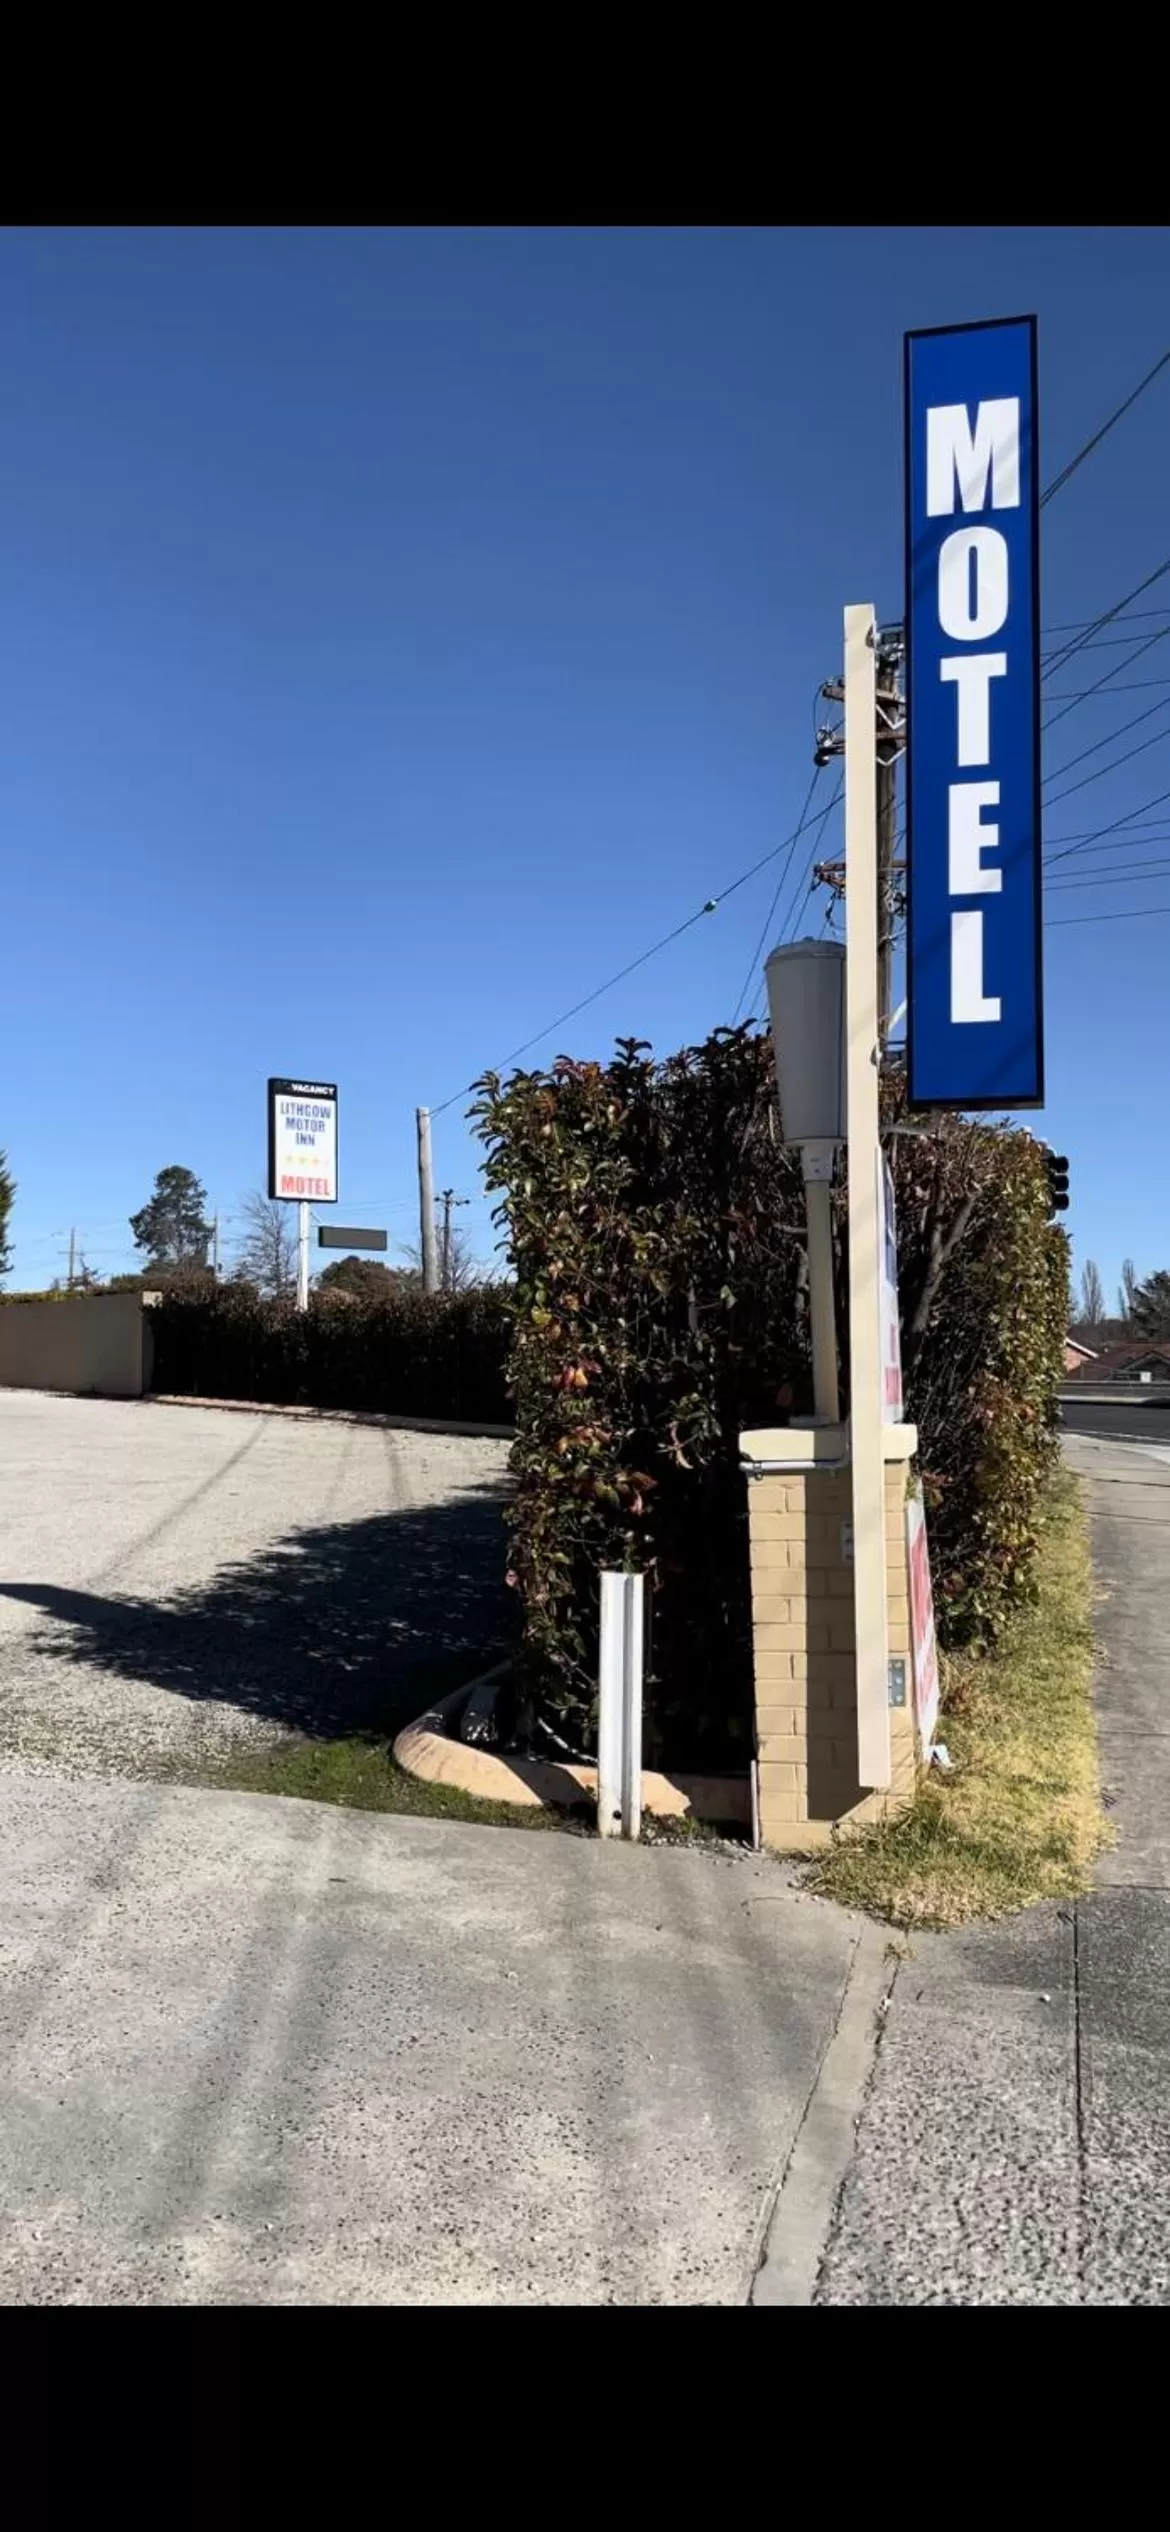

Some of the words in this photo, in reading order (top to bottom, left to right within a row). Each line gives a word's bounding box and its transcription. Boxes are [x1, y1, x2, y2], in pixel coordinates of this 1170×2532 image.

[926, 397, 1020, 1023] MOTEL
[292, 1083, 336, 1095] VACANCY
[280, 1101, 332, 1119] LITHGOW
[286, 1117, 326, 1132] MOTOR
[295, 1132, 315, 1146] INN
[281, 1174, 331, 1196] MOTEL
